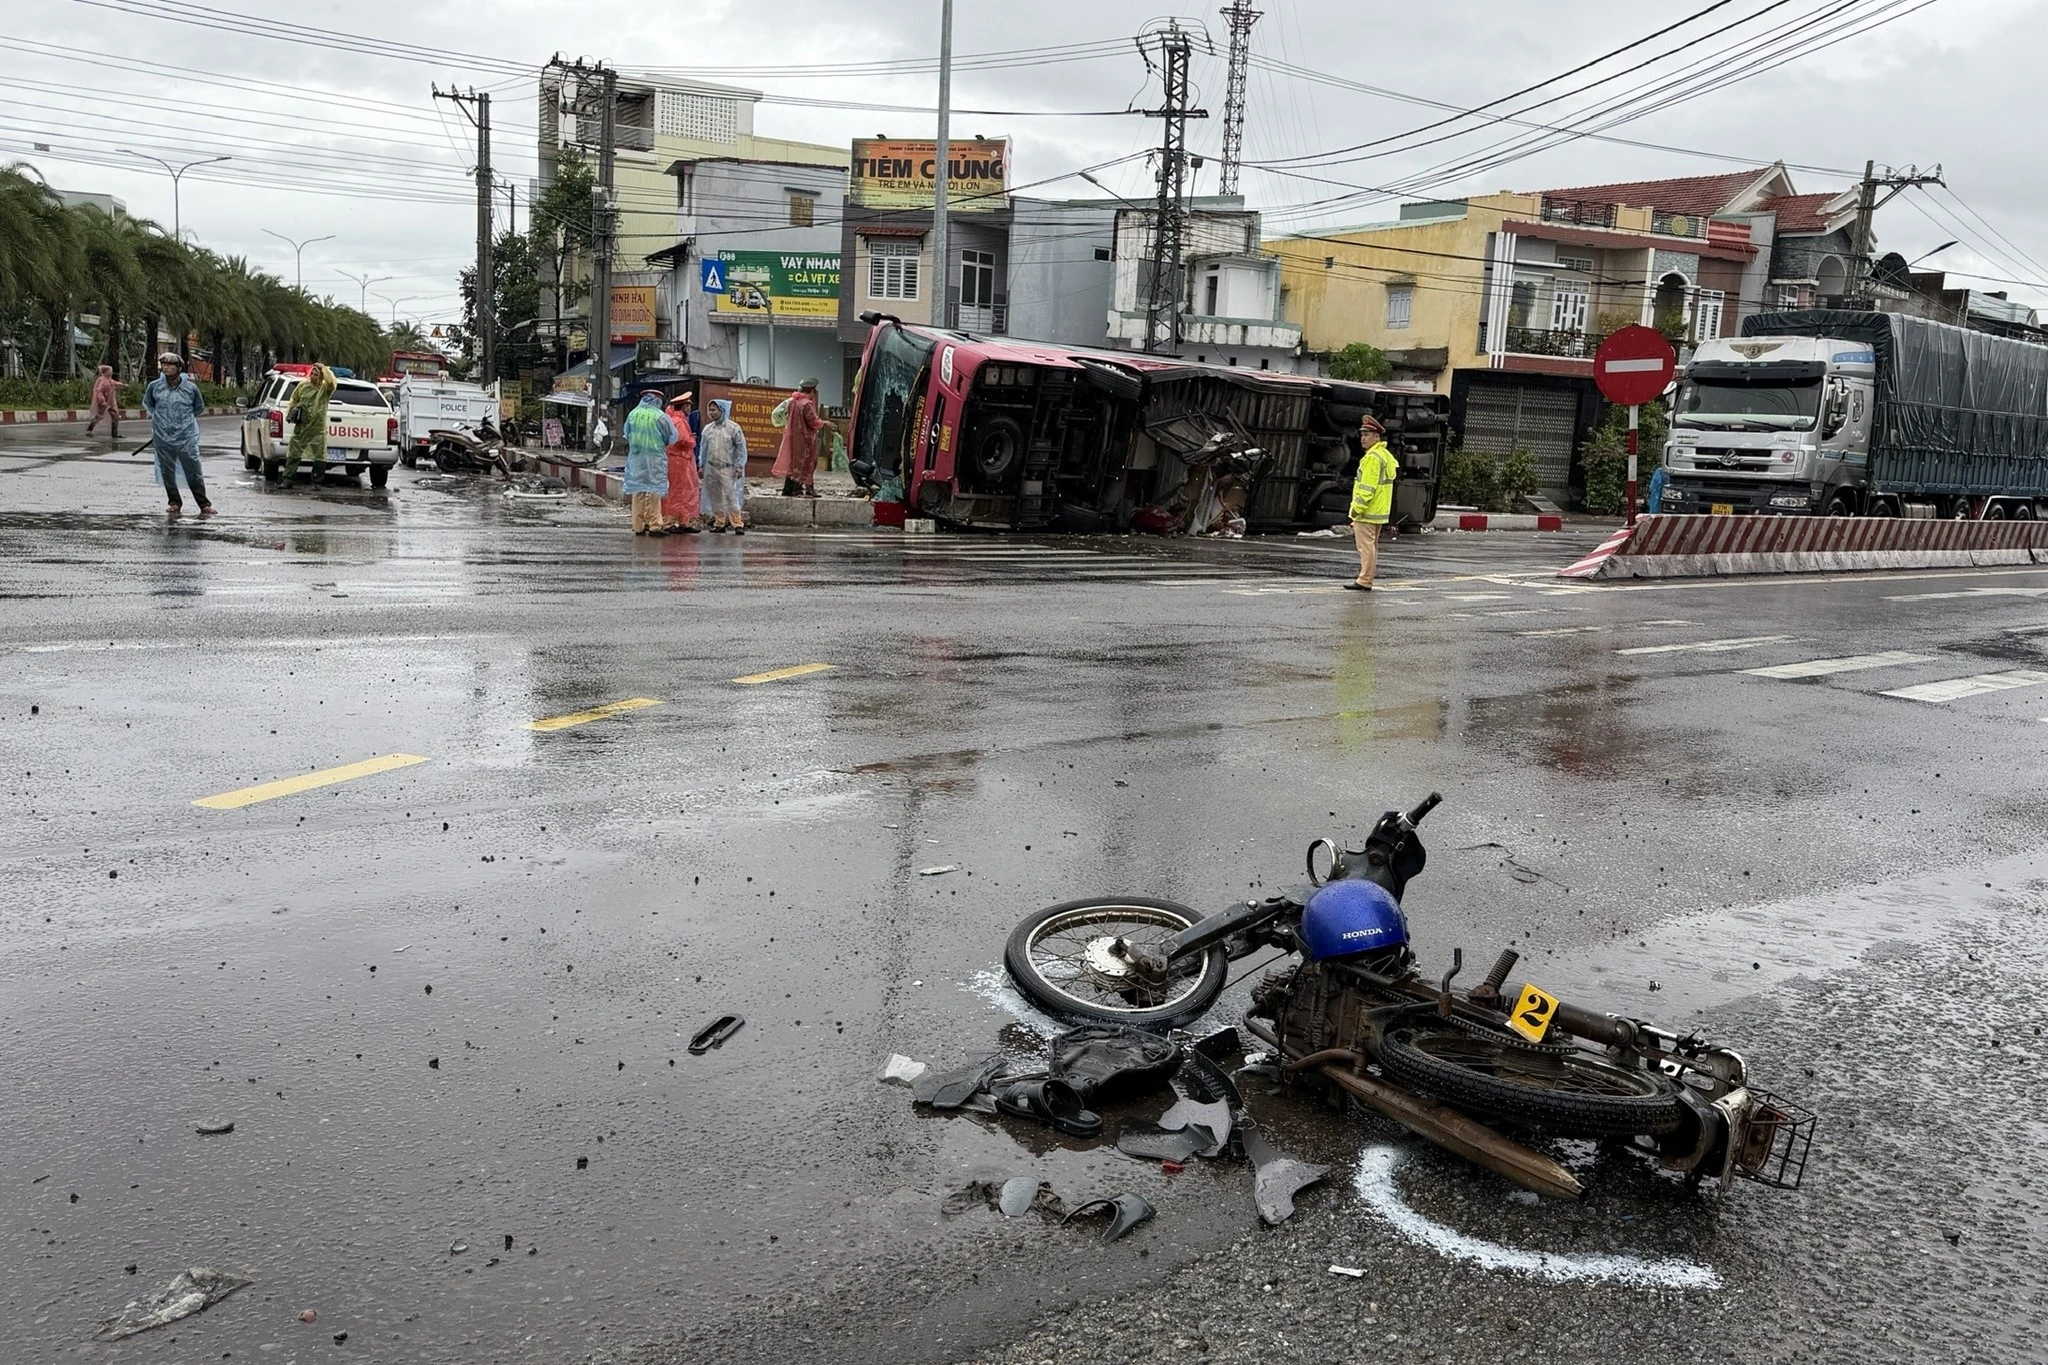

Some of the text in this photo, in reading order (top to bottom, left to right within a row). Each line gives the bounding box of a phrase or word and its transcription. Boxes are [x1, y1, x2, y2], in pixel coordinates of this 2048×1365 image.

[897, 180, 911, 189] EM
[780, 256, 804, 269] VAY
[806, 257, 841, 270] NHAN
[795, 271, 808, 284] CÀ
[811, 273, 827, 286] VẸT
[828, 274, 840, 284] XE
[440, 403, 467, 412] POLICE
[736, 402, 759, 414] CÔNG
[326, 426, 374, 439] UBISHI
[1342, 927, 1384, 940] HONDA
[1519, 993, 1550, 1027] 2
